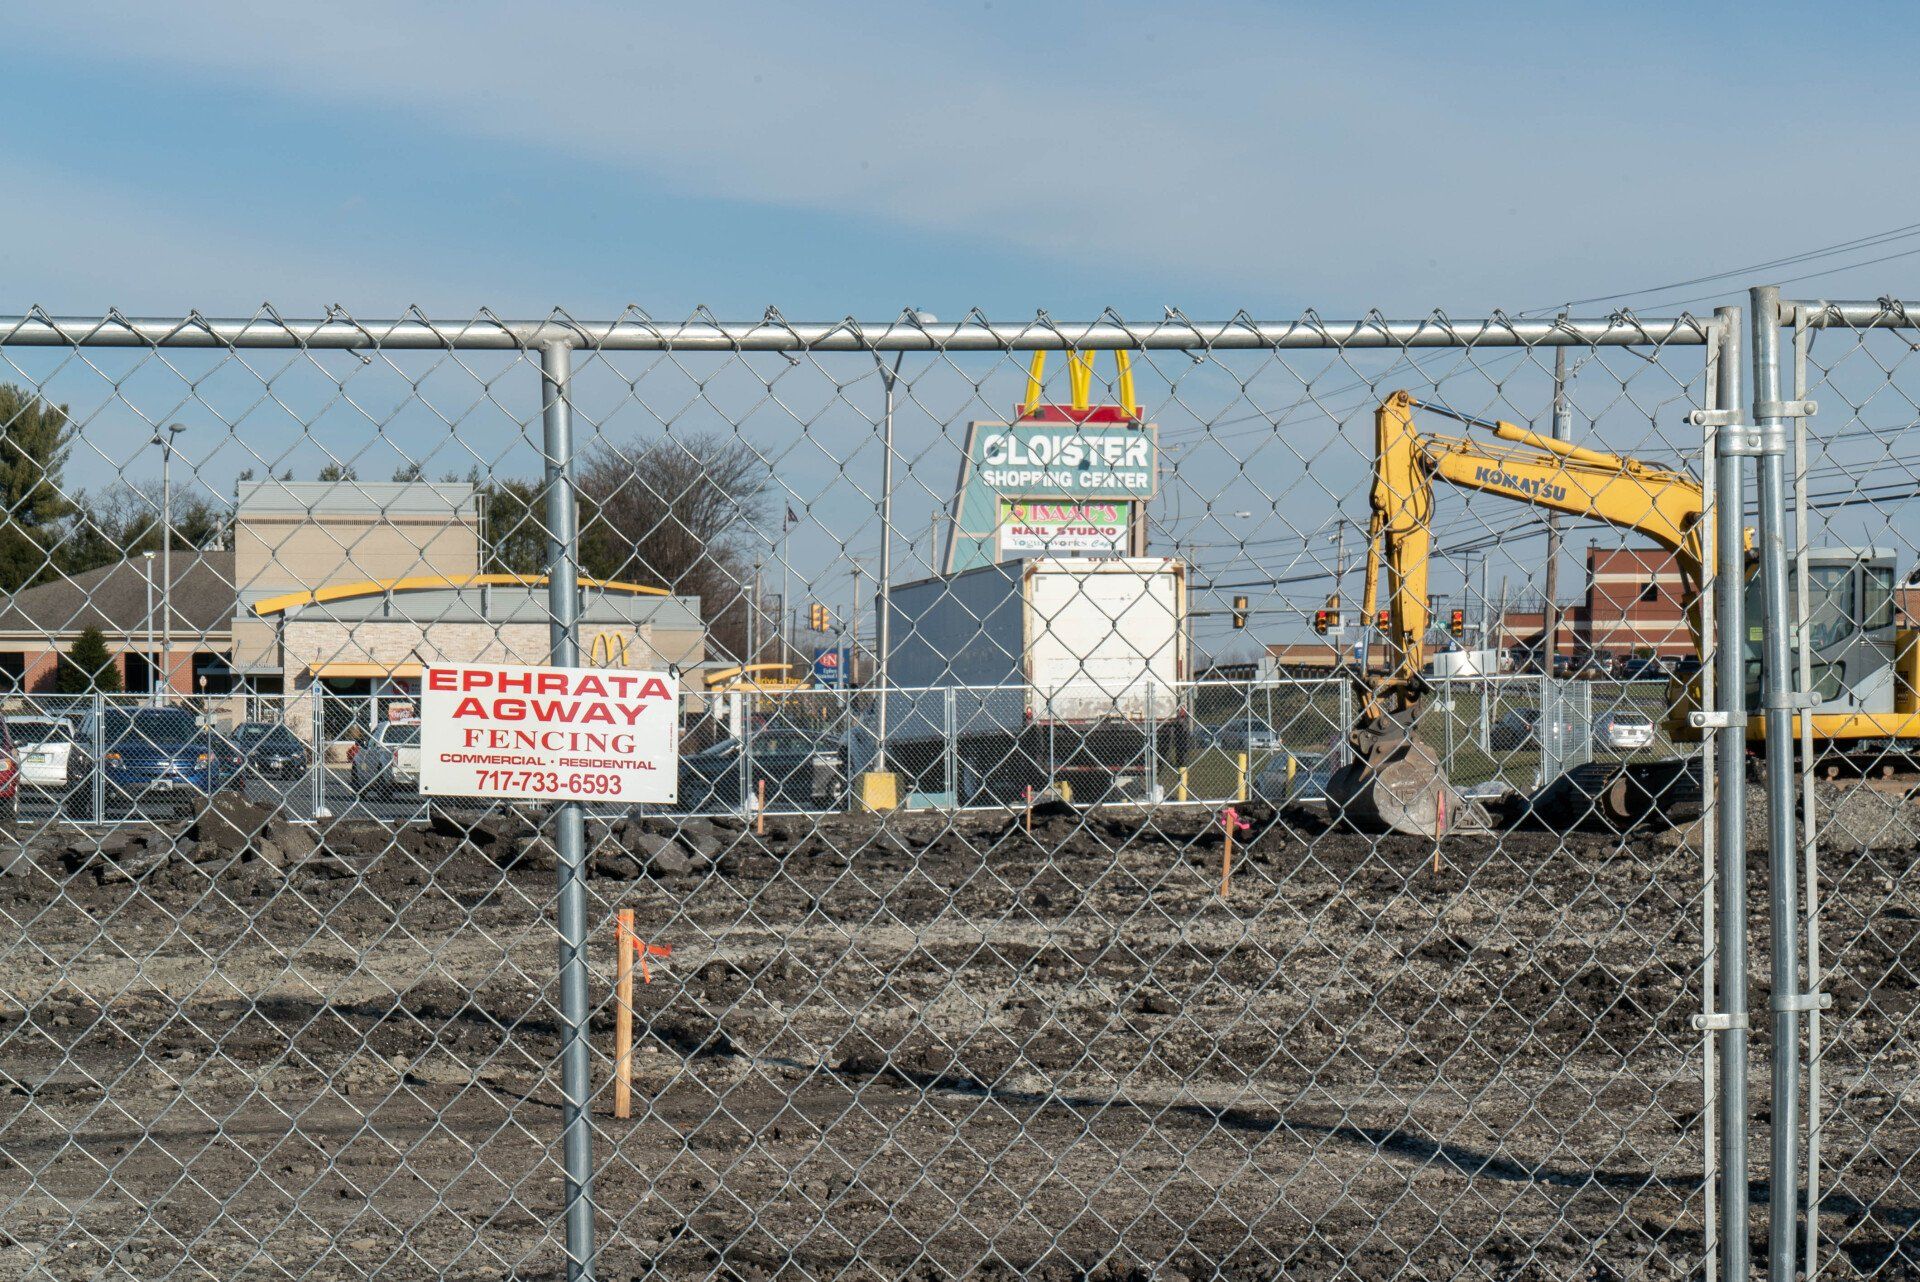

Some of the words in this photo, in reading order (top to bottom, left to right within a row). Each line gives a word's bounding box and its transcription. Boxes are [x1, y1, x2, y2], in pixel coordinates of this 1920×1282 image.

[983, 434, 1149, 467] CLOISTER
[983, 470, 1072, 487] SHOPPING
[1079, 473, 1148, 488] CENTER
[1475, 466, 1566, 501] KOMATSU
[1029, 504, 1118, 523] ISAAC'S
[1011, 527, 1049, 535] NAIL
[1057, 527, 1116, 535] STUDIO
[429, 668, 672, 700] EPHRATA
[452, 697, 648, 725] AGWAY
[463, 728, 636, 753] FENCING
[440, 753, 545, 765] COMMERCIAL
[559, 757, 656, 770] RESIDENTIAL
[476, 770, 622, 795] 717-733-6593
